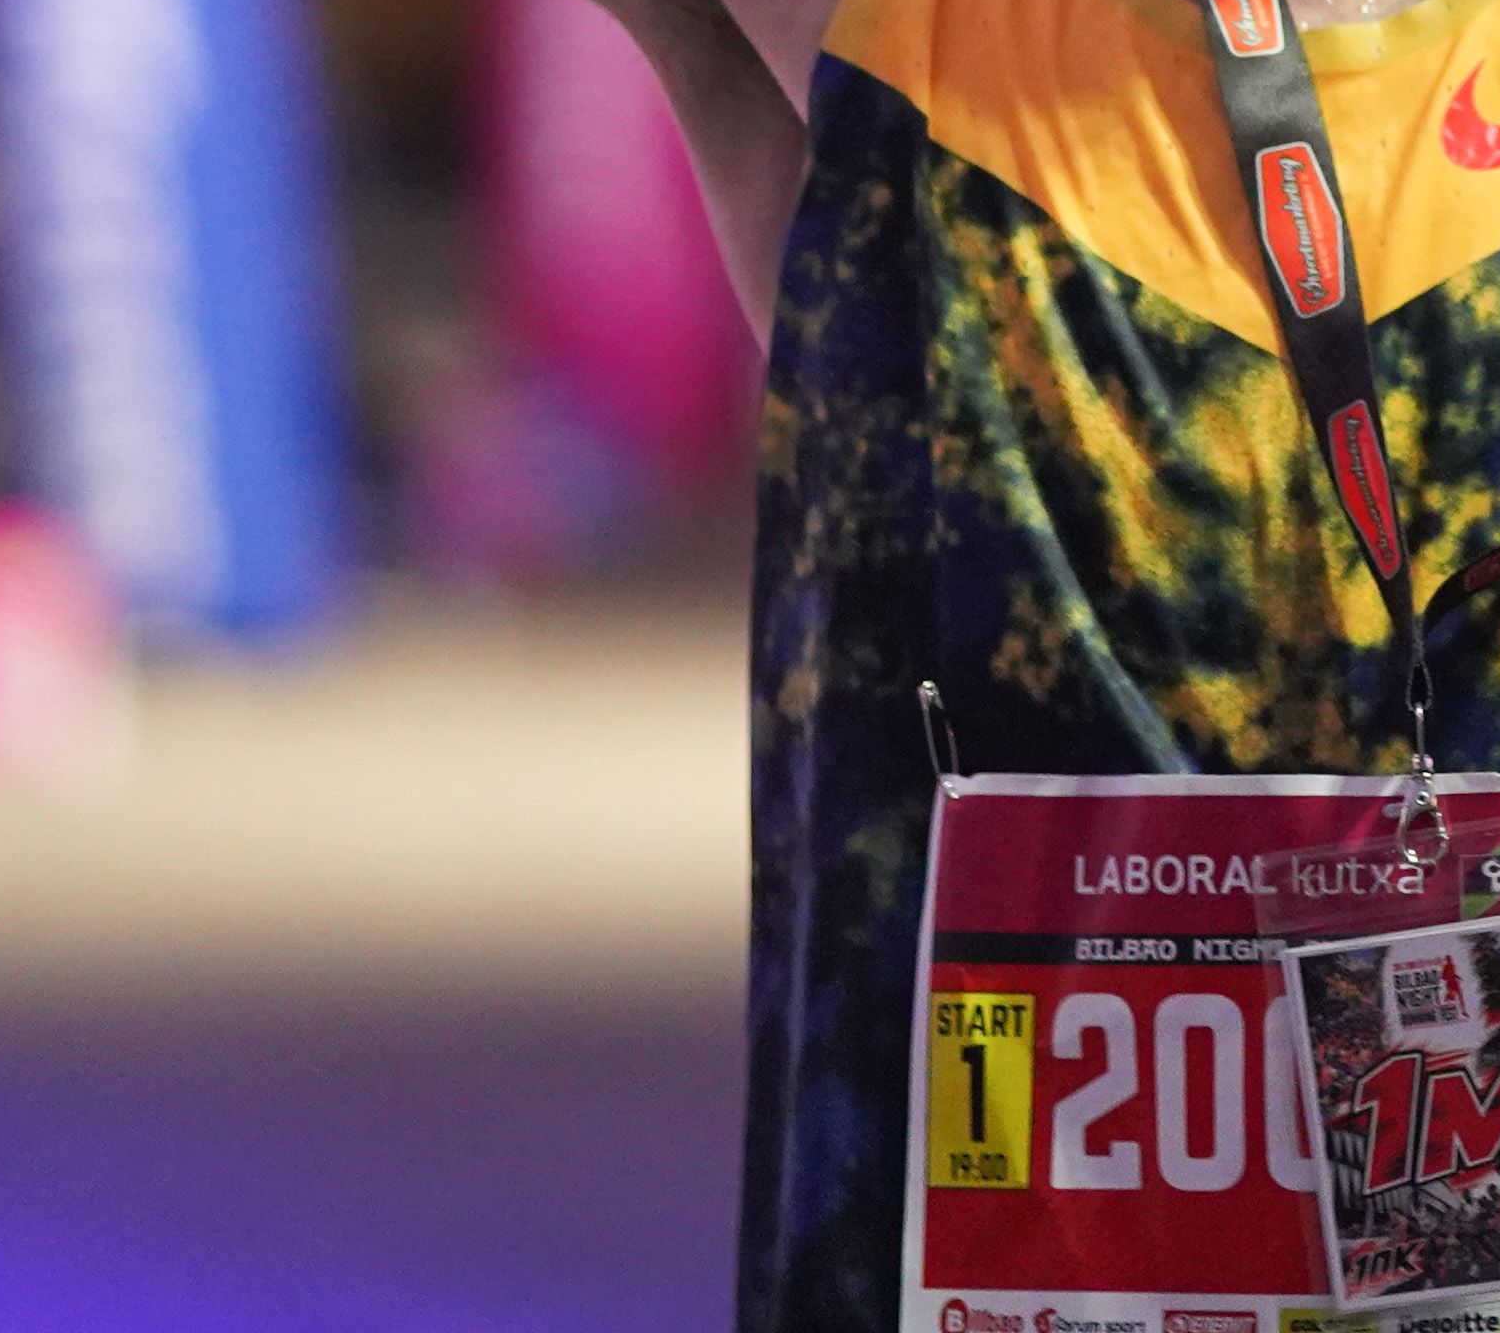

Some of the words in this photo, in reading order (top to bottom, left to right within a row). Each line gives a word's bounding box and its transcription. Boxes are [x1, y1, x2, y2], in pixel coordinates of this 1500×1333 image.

[1074, 855, 1278, 895] LABORAL
[1291, 855, 1425, 899] kutxa
[1075, 938, 1178, 961] BILBAO
[937, 1002, 1026, 1038] START
[960, 1044, 987, 1143] 1
